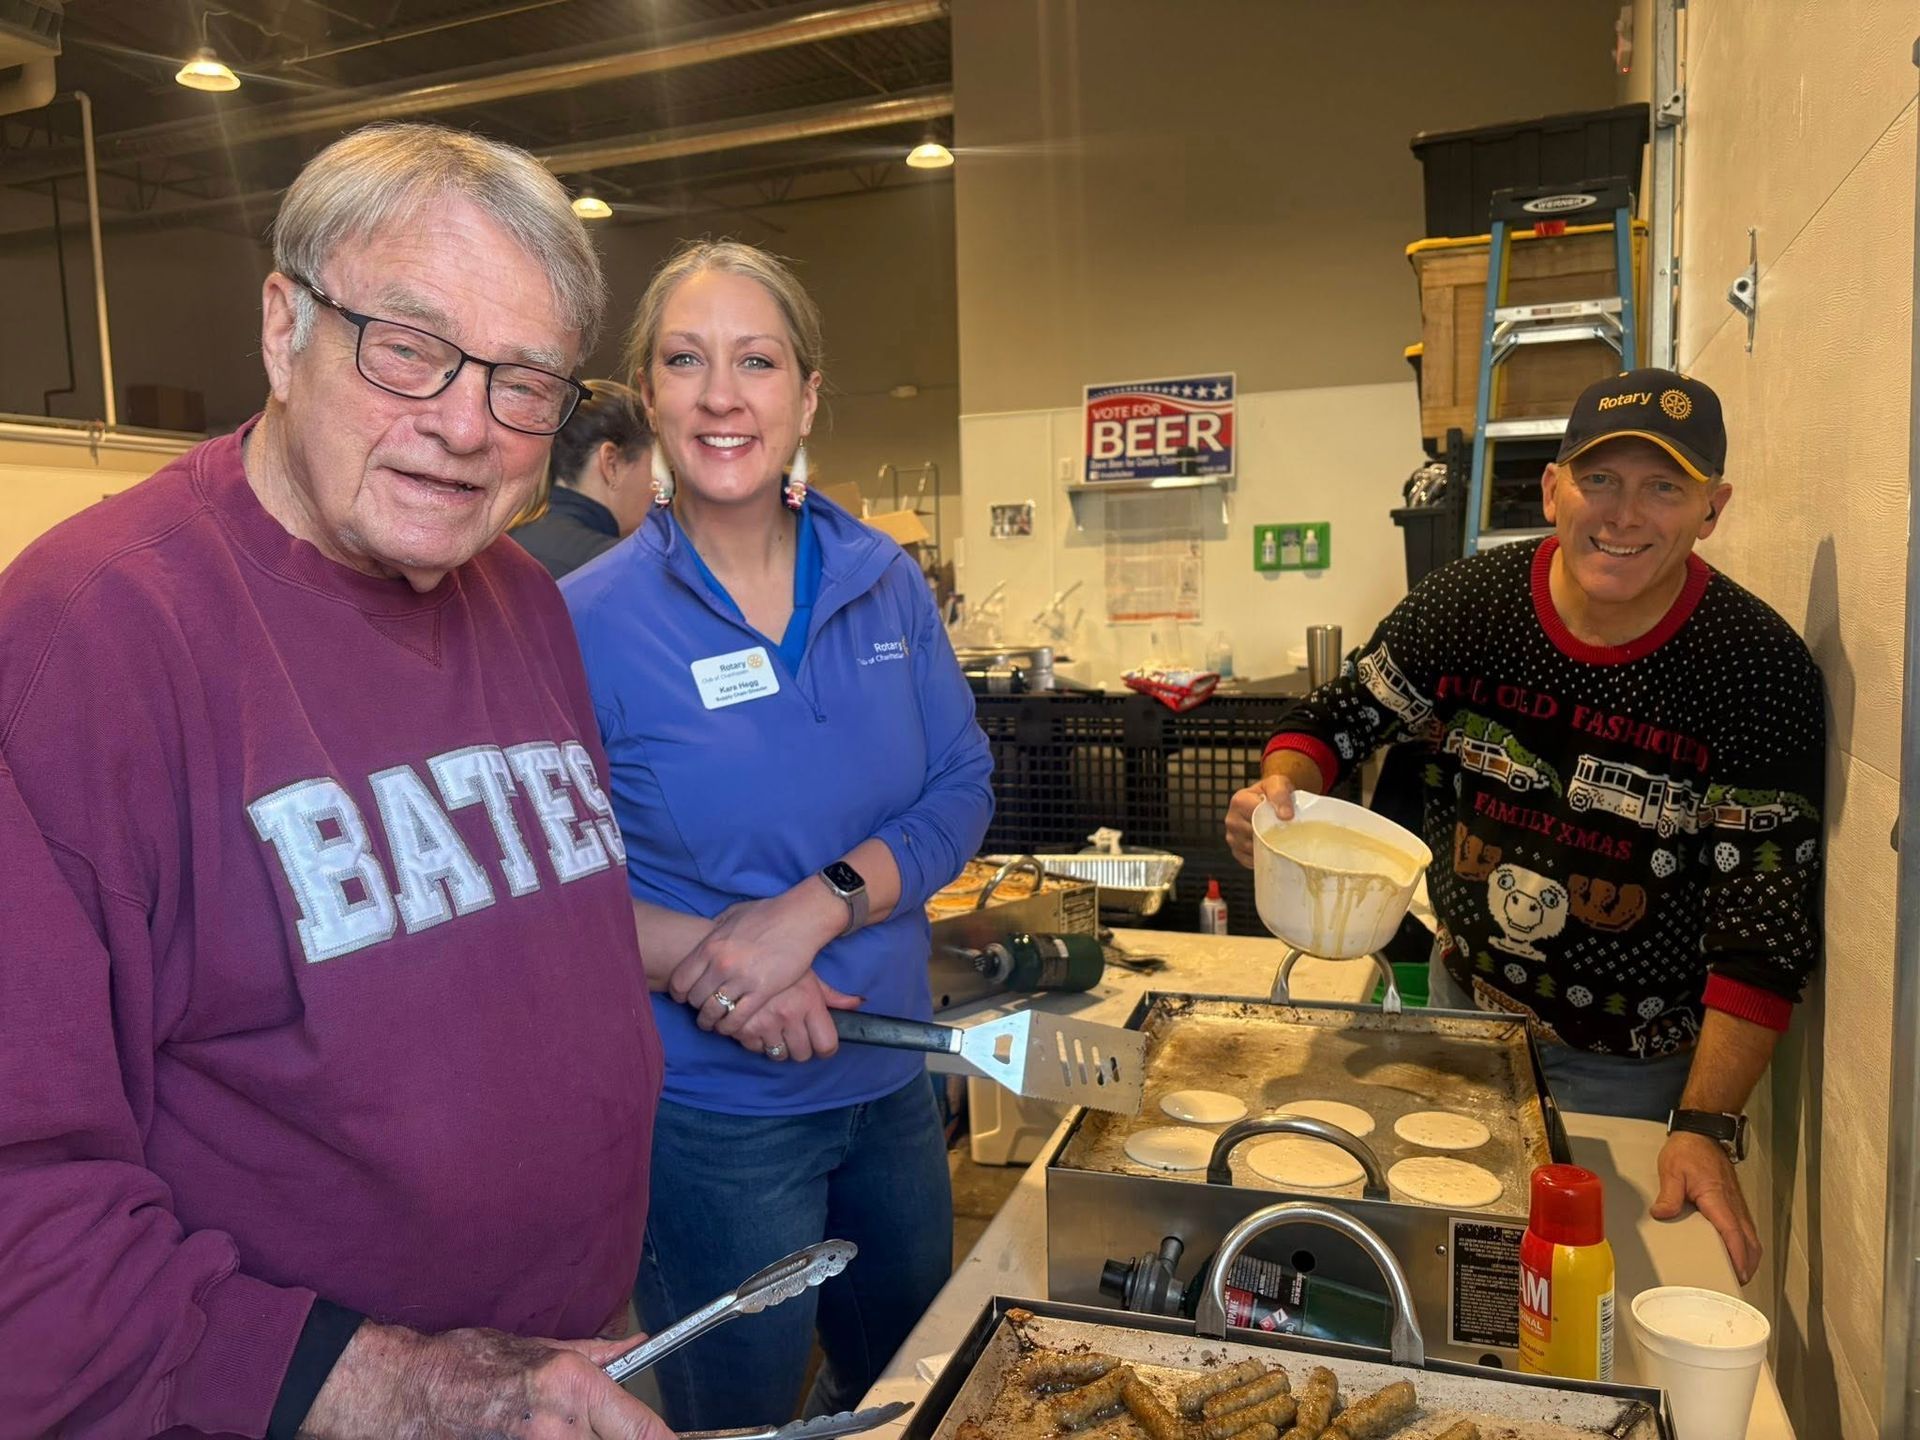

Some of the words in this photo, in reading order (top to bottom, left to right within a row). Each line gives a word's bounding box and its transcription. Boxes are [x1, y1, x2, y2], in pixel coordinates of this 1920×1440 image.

[1538, 199, 1582, 210] WERNER
[1598, 391, 1654, 412] Rotary
[1092, 406, 1130, 420] VOTE
[1132, 403, 1162, 417] FOR
[1092, 412, 1225, 460] BEER
[873, 641, 903, 653] Rotary
[720, 661, 746, 672] Rotary
[720, 684, 737, 693] Kara
[738, 680, 759, 690] Hegg
[1497, 684, 1559, 720] OLD
[1474, 791, 1557, 835] FAMILY
[1554, 821, 1633, 861] XMAS
[247, 740, 628, 964] BATES
